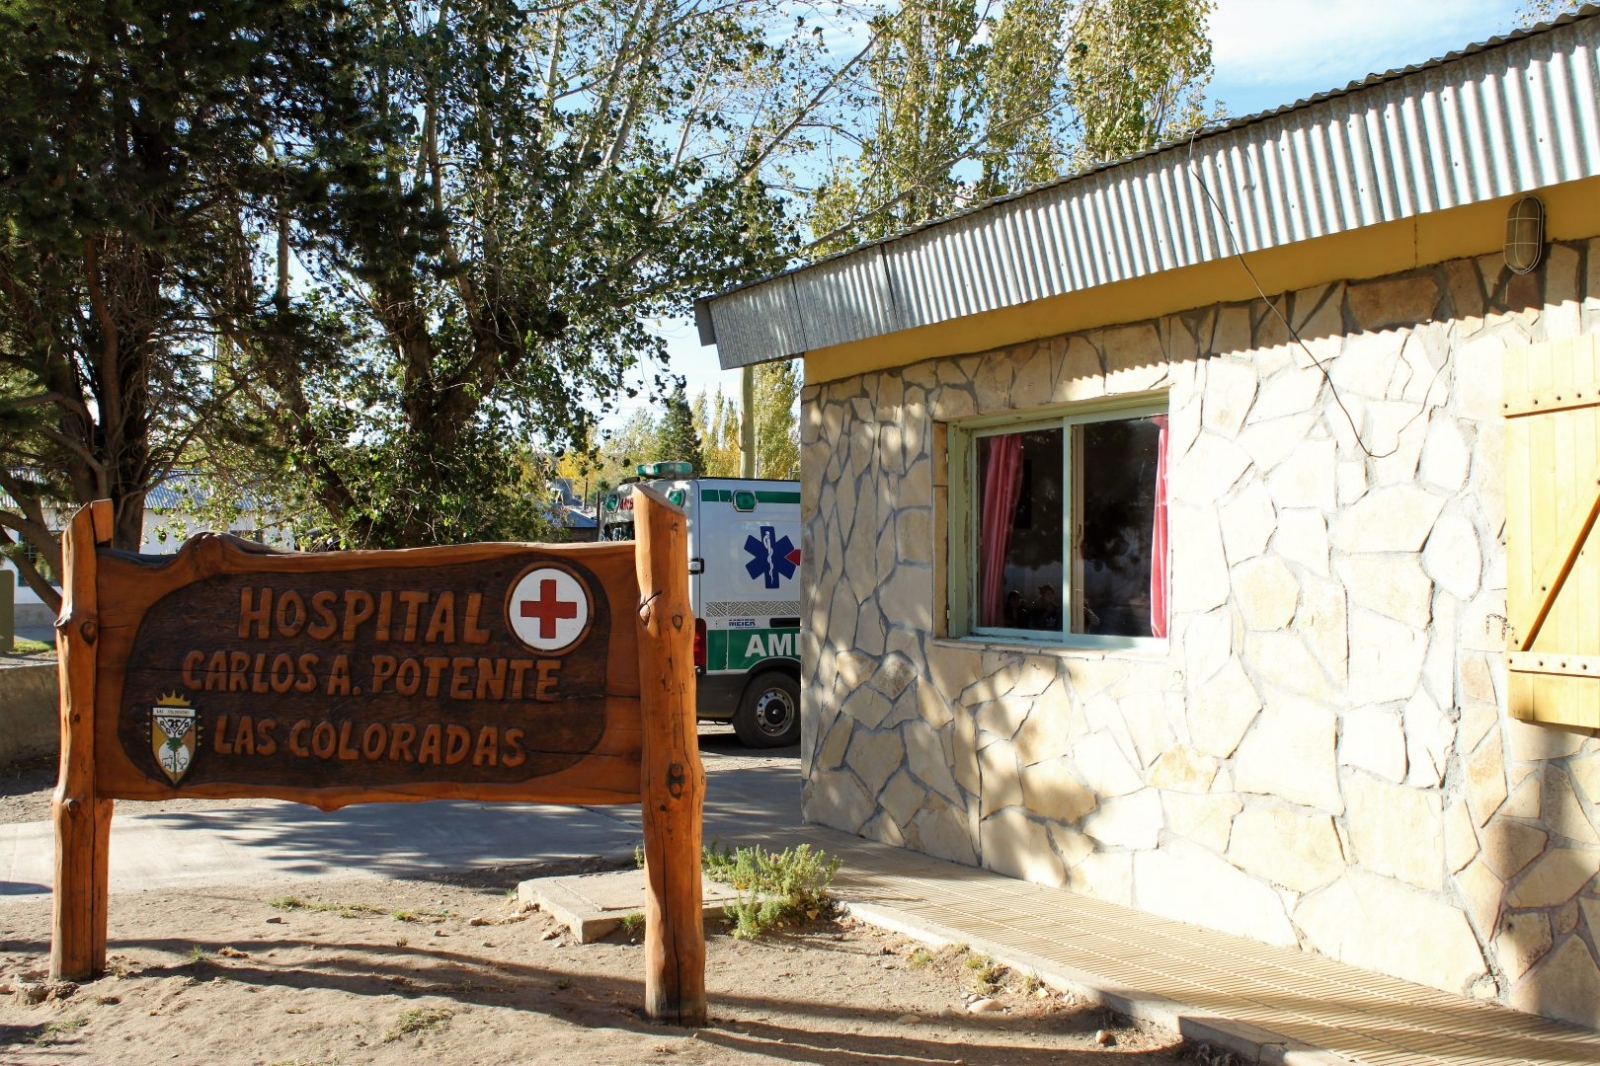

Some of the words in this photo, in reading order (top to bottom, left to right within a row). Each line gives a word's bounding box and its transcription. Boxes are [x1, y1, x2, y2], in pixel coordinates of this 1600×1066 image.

[237, 586, 491, 645] HOSPITAL
[729, 618, 756, 627] MEIER
[181, 650, 318, 694] CARLOS
[327, 654, 361, 696] A.
[371, 655, 563, 702] POTENTE
[214, 715, 277, 756] LAS
[288, 718, 528, 768] COLORADAS
